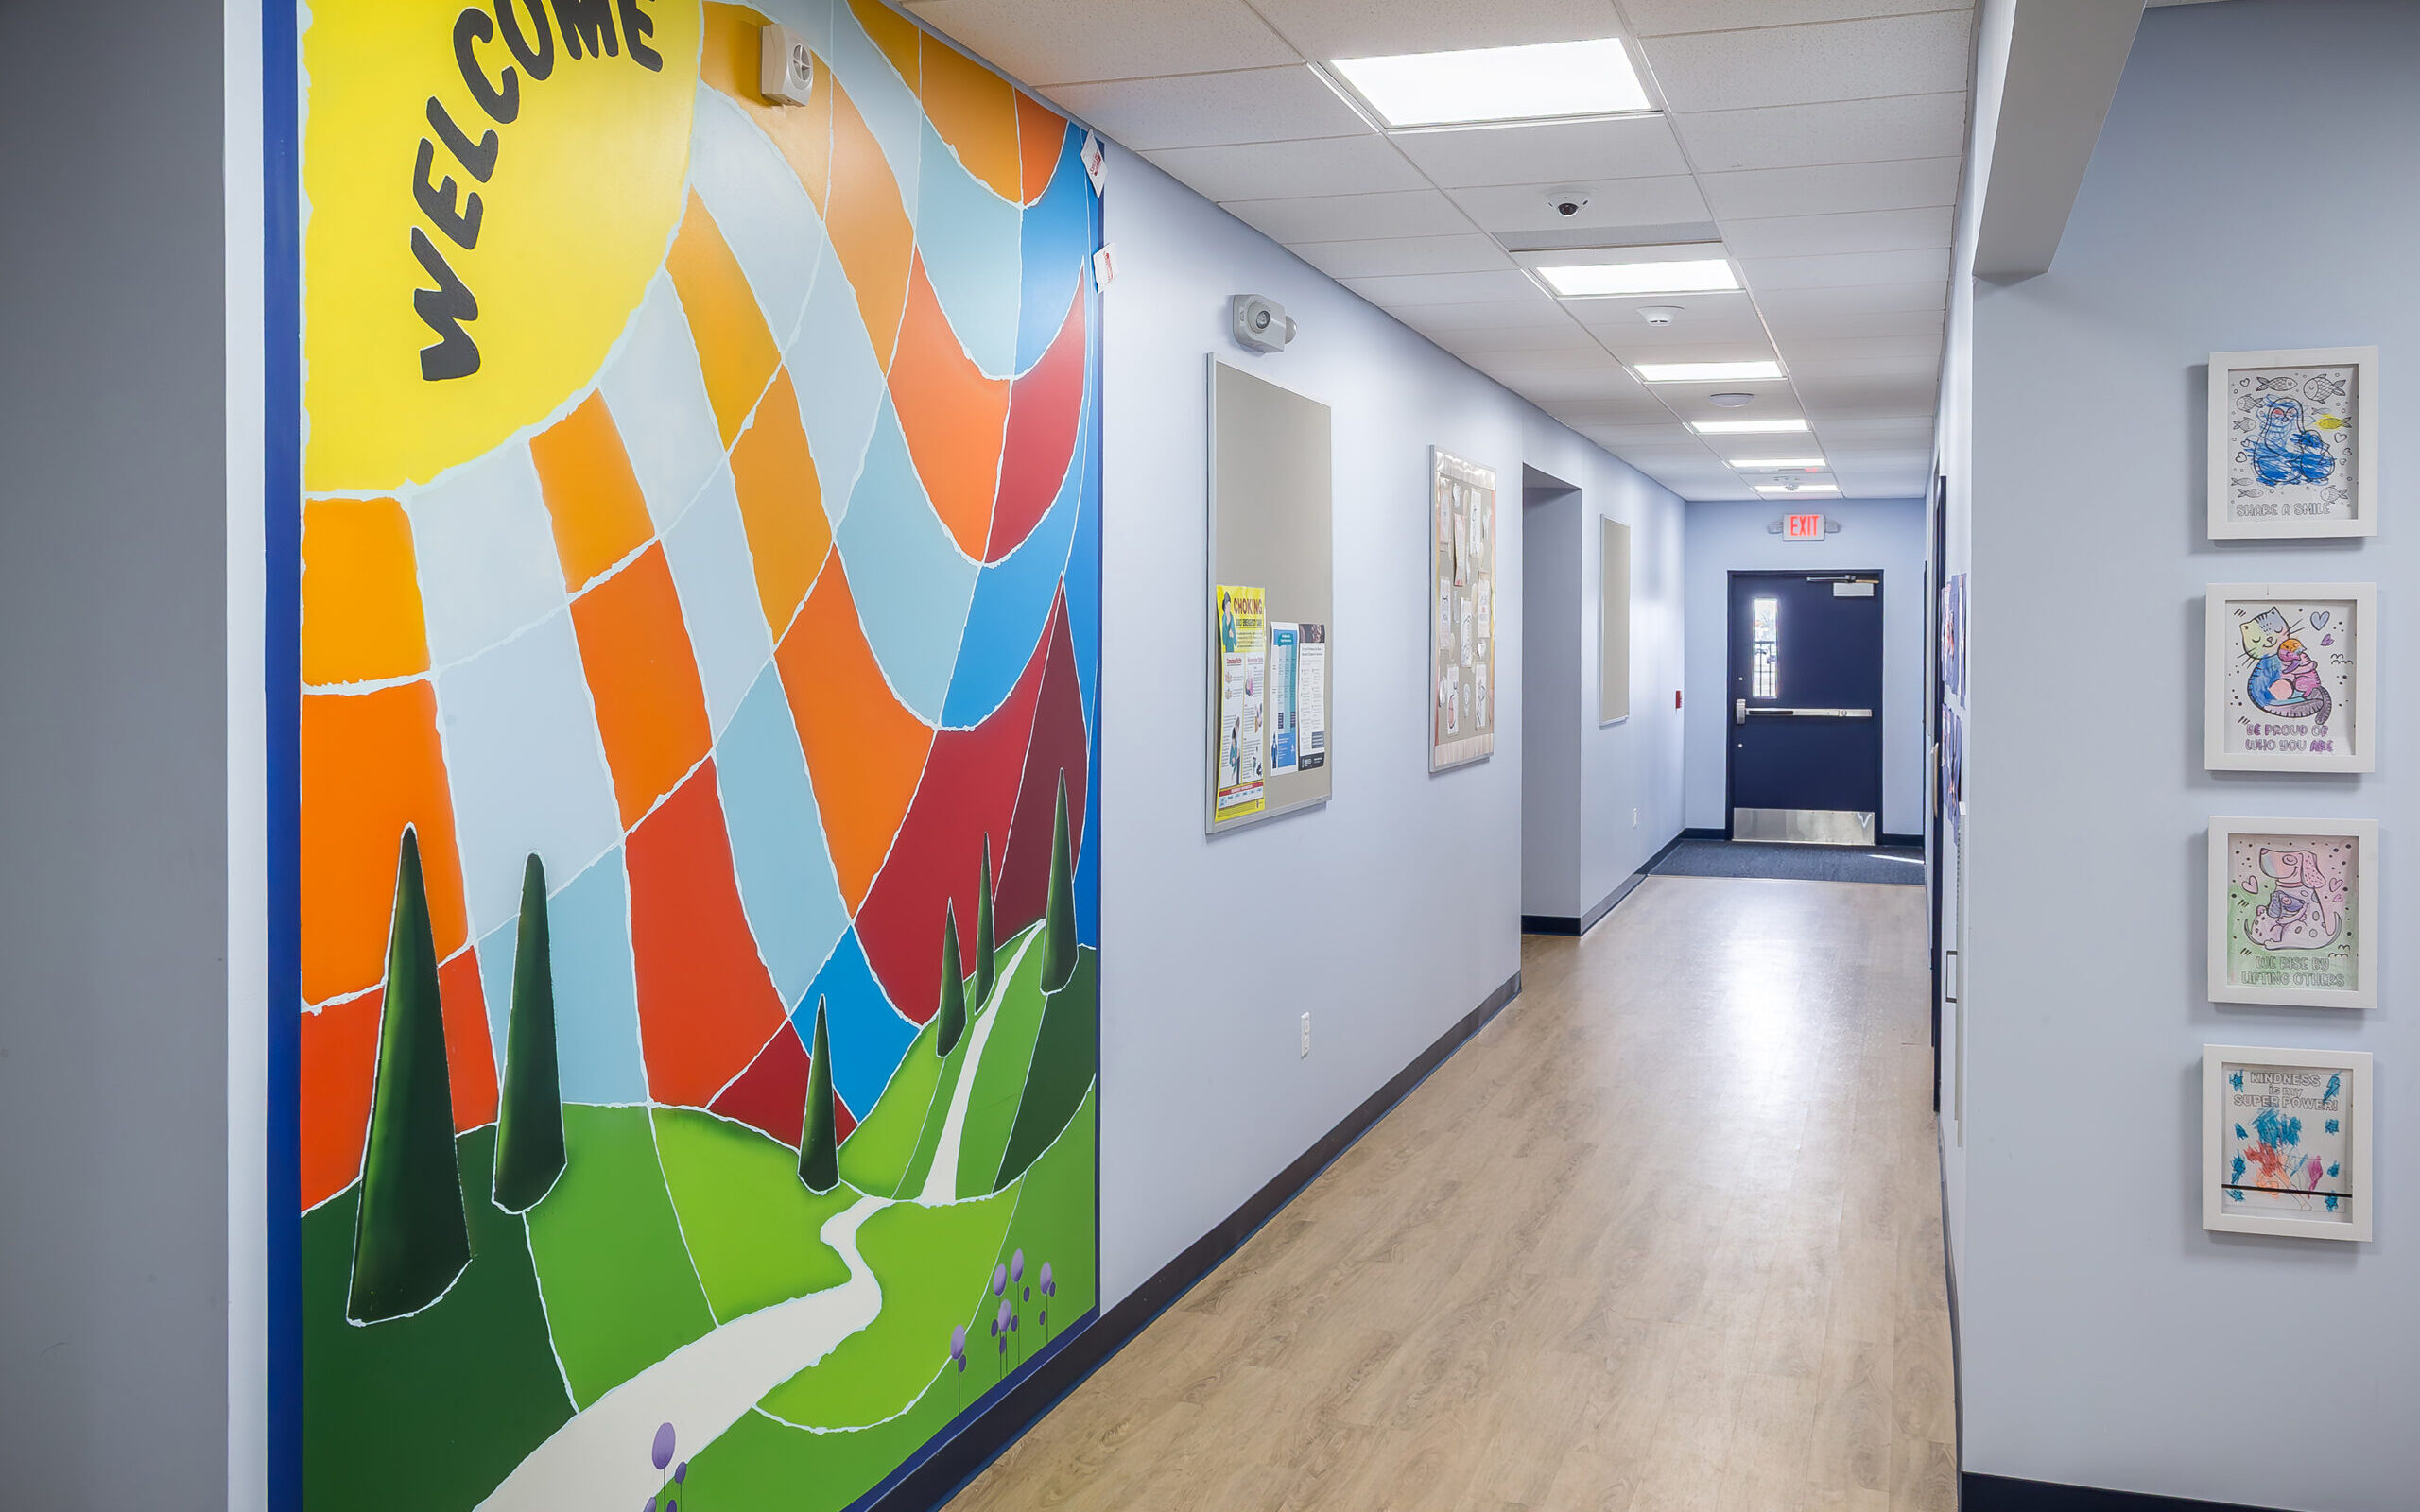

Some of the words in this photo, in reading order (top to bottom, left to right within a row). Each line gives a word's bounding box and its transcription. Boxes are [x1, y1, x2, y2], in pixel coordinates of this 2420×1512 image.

[411, 0, 663, 381] WELCOME
[2236, 503, 2278, 517] SHARE
[2281, 504, 2291, 516] A
[2294, 502, 2330, 516] SMILE
[1790, 515, 1819, 536] EXIT
[1233, 597, 1263, 615] CHOKING
[2246, 723, 2261, 736] BE
[2265, 724, 2308, 736] PROUD
[2311, 724, 2328, 737] OF
[2245, 738, 2276, 751] WHO
[2279, 739, 2307, 751] YOU
[2309, 740, 2334, 752] ARE
[2255, 955, 2276, 970] WE
[2279, 956, 2308, 970] RISE
[2311, 956, 2329, 971] BY
[2241, 971, 2290, 986] LIFTING
[2293, 973, 2345, 987] OTHERS
[2250, 1072, 2321, 1086] KINDNESS
[2269, 1085, 2280, 1094] is
[2282, 1088, 2303, 1098] my
[2234, 1094, 2279, 1108] SUPER
[2282, 1096, 2339, 1111] POWER!
